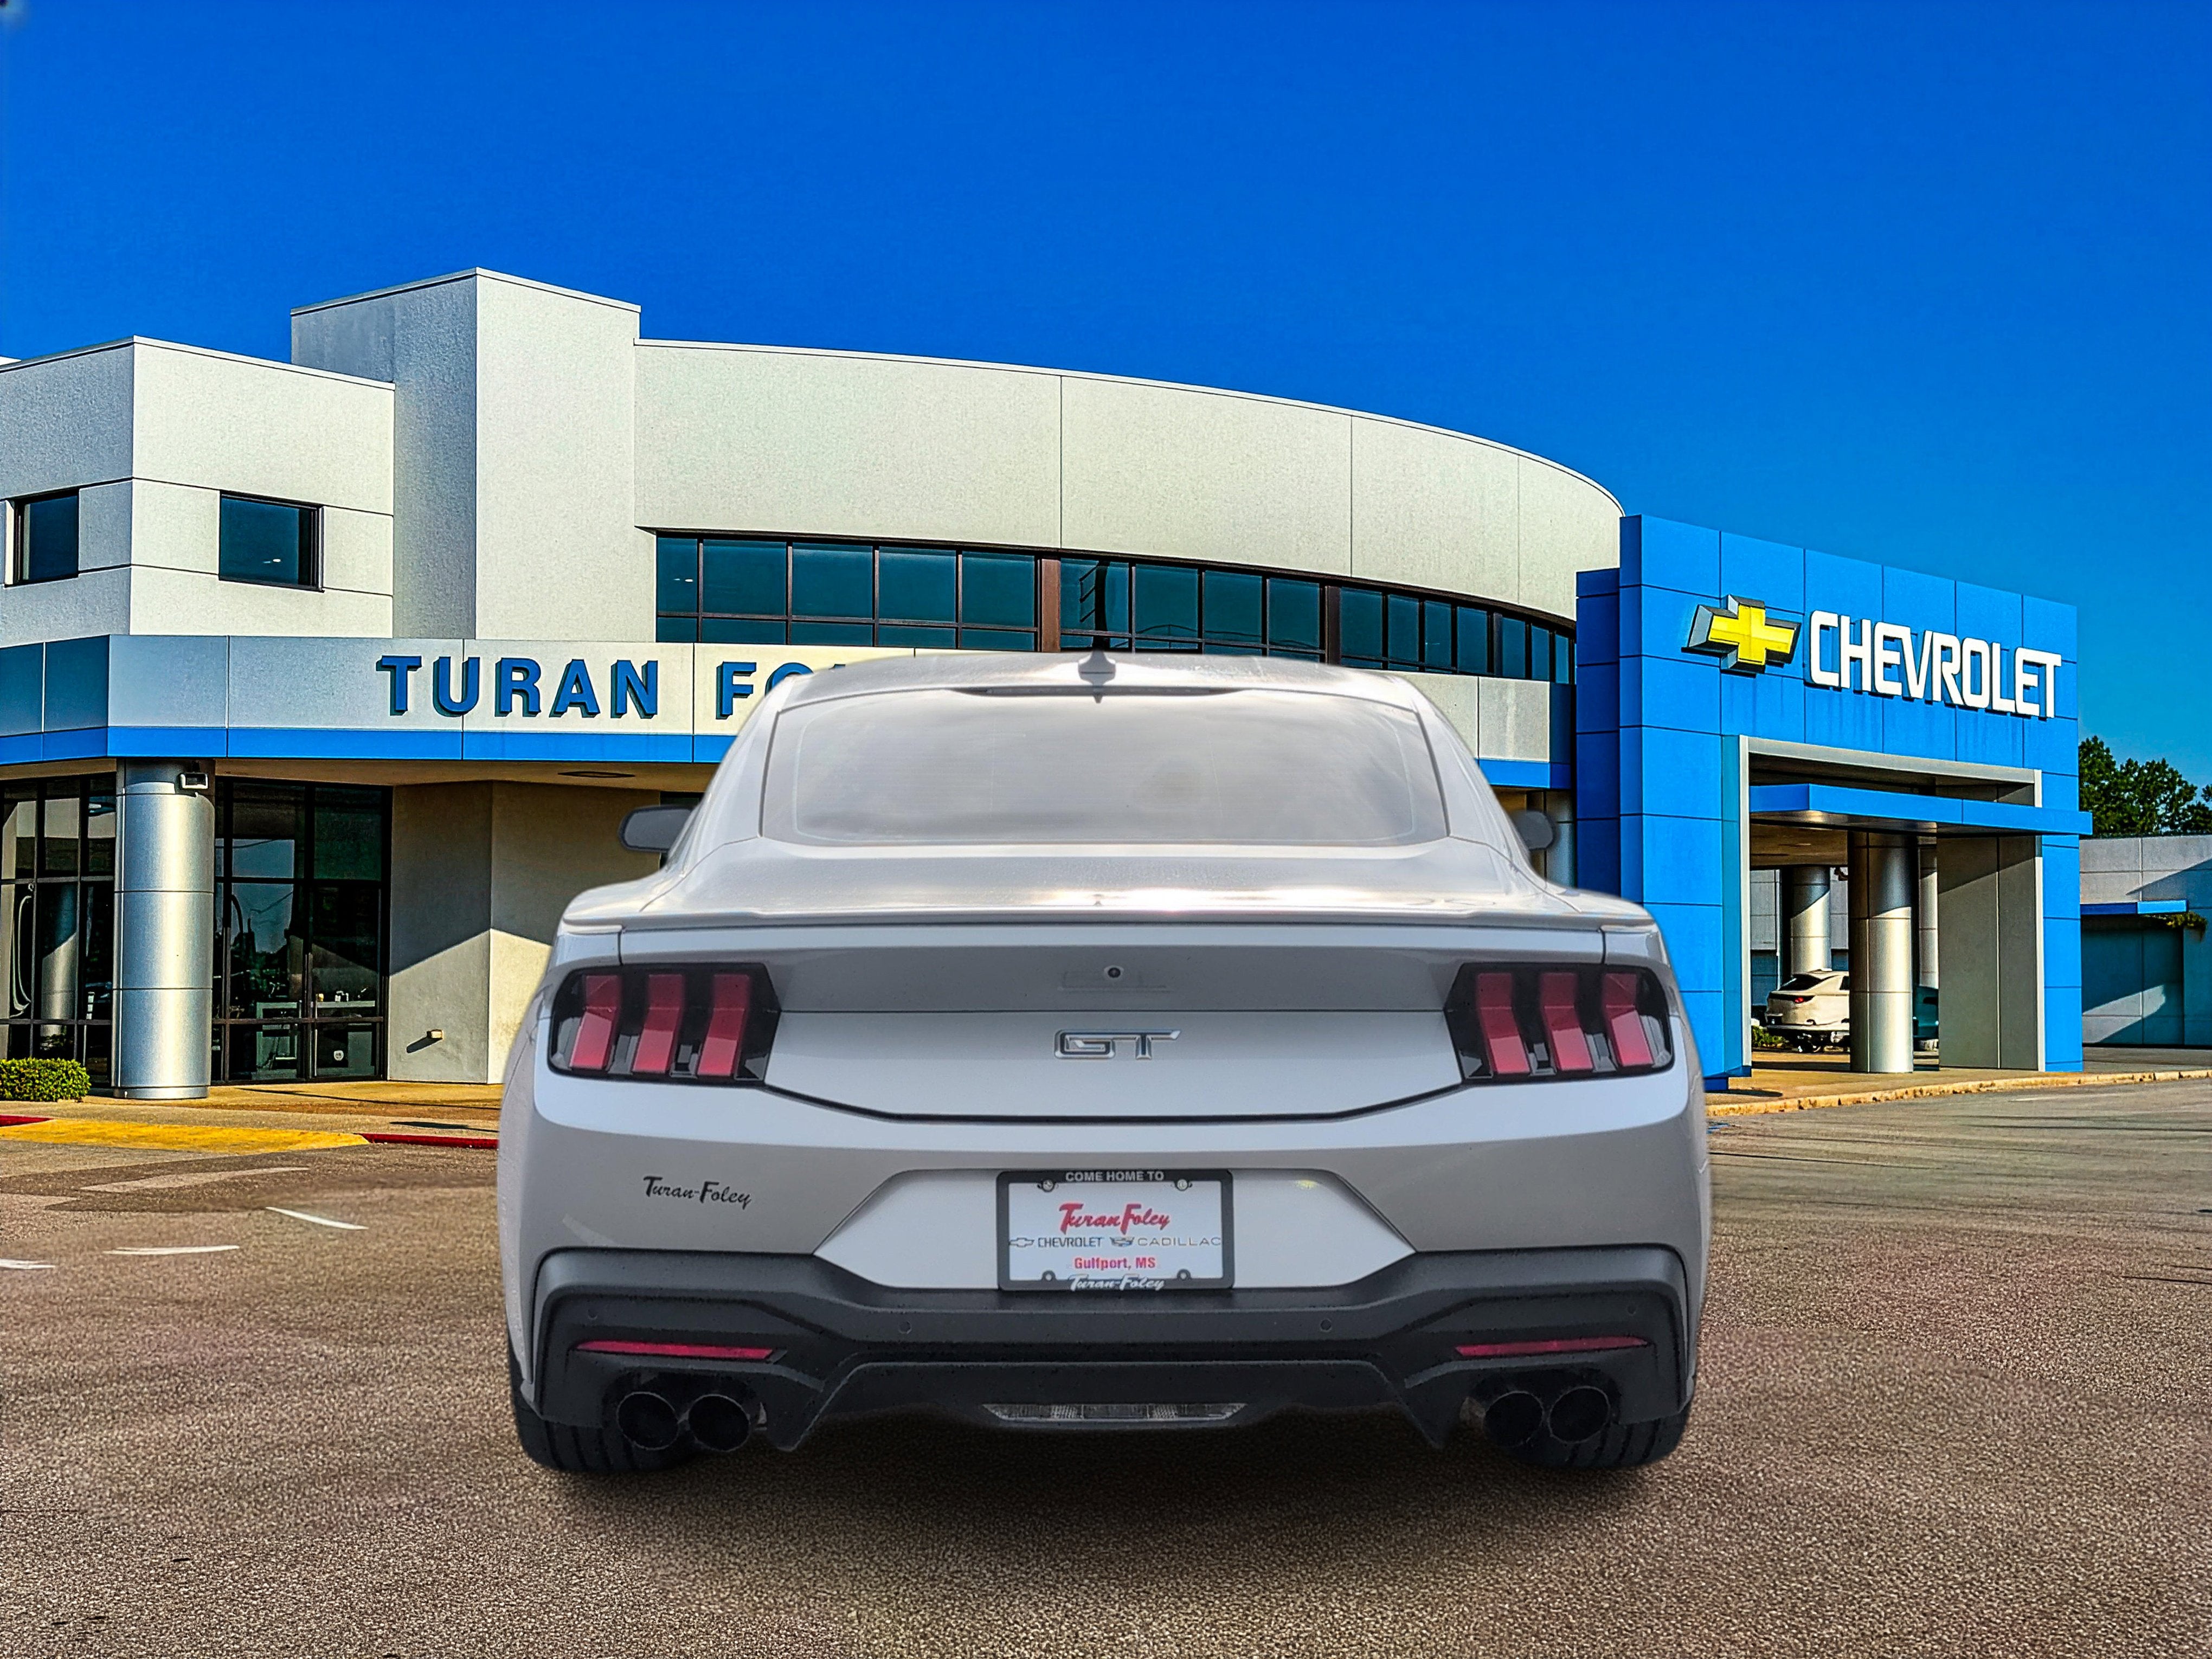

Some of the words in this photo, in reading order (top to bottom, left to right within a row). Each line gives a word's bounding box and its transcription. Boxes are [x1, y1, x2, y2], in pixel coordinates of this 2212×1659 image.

[1809, 610, 2062, 719] CHEVROLET
[376, 655, 659, 720] TURAN
[1054, 1030, 1181, 1060] GT
[1065, 1171, 1103, 1182] COME
[1106, 1171, 1143, 1181] HOME
[1147, 1171, 1165, 1181] TO
[643, 1175, 752, 1210] Turan-Foley
[1038, 1237, 1102, 1248] CHEVROLET
[1137, 1237, 1221, 1246] CADILLAC
[1074, 1257, 1131, 1270] Gulfport,
[1135, 1257, 1156, 1269] MS
